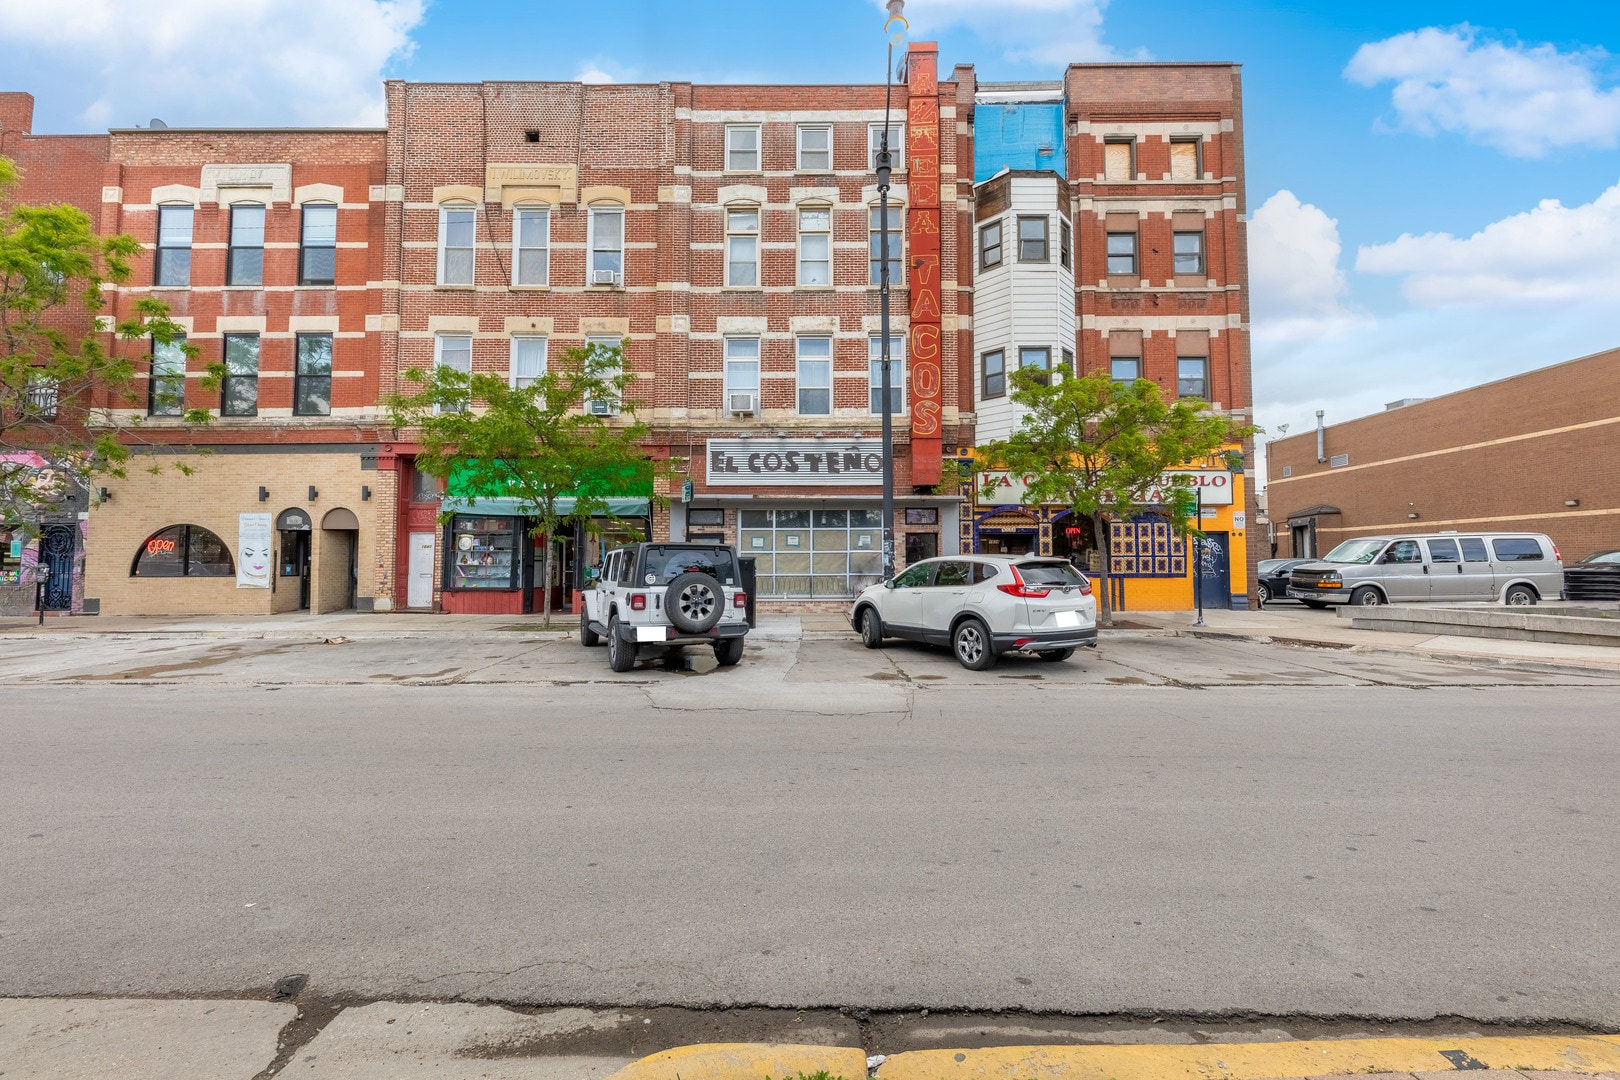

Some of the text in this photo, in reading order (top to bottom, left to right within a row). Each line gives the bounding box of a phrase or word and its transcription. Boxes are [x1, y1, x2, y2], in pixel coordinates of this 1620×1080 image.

[910, 72, 940, 436] AZTECA TACOS
[711, 445, 883, 474] EL COSTEÑO
[983, 474, 1012, 487] LA
[1149, 475, 1227, 487] UEBLO
[1065, 527, 1081, 535] OPEN
